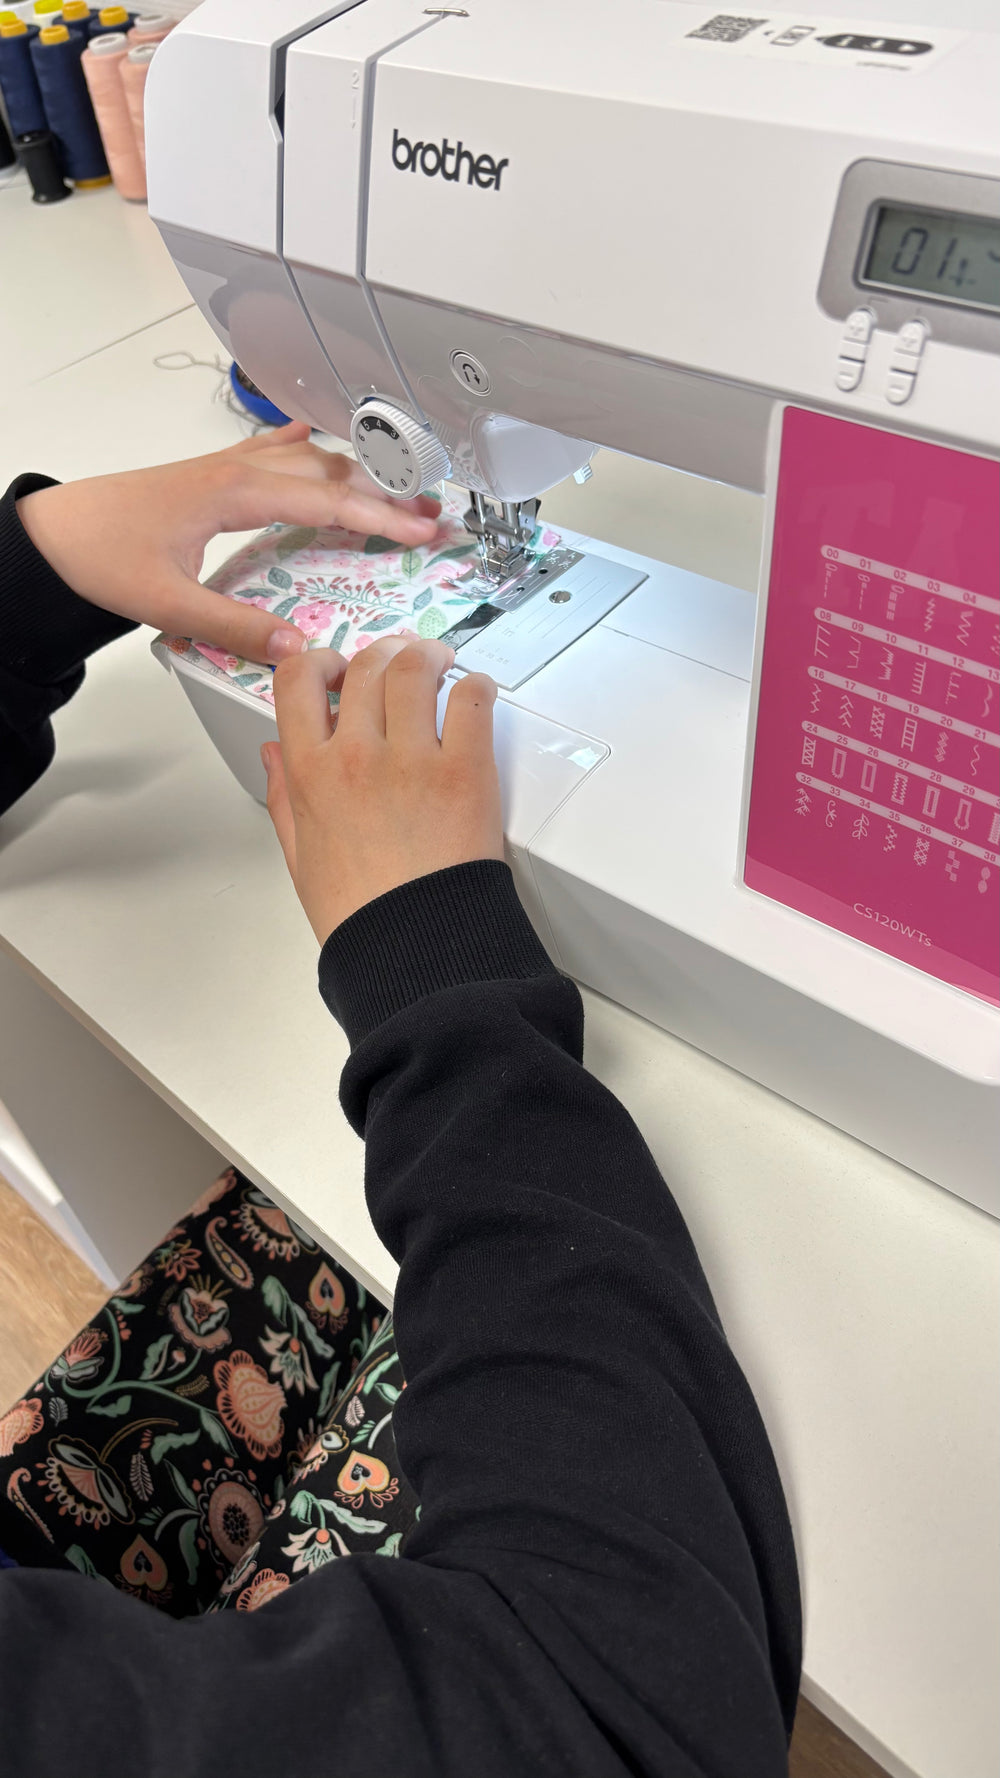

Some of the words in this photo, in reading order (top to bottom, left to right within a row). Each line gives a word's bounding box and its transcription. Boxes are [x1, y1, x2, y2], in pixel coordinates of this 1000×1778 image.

[392, 128, 509, 191] brother
[891, 227, 958, 279] 01
[363, 421, 370, 430] 5
[376, 419, 382, 428] 4
[390, 430, 397, 438] 3
[389, 479, 395, 488] 9
[400, 478, 407, 487] 0
[826, 549, 839, 559] 00
[860, 559, 872, 570] 01
[893, 569, 907, 581] 02
[927, 581, 940, 592] 03
[963, 592, 976, 604] 04
[820, 611, 831, 621] 08
[852, 621, 864, 633] 09
[886, 634, 897, 644] 10
[918, 645, 929, 655] 11
[952, 657, 964, 668] 12
[988, 669, 1000, 681] 13
[814, 669, 824, 679] 16
[845, 680, 856, 690] 17
[877, 692, 888, 702] 18
[908, 704, 919, 714] 19
[940, 716, 953, 727] 20
[975, 729, 986, 740] 21
[807, 723, 818, 734] 24
[837, 735, 848, 745] 25
[868, 747, 879, 757] 26
[897, 759, 909, 769] 27
[930, 772, 942, 782] 28
[963, 785, 975, 796] 29
[801, 774, 812, 784] 32
[829, 786, 841, 796] 33
[859, 799, 871, 809] 34
[889, 810, 900, 820] 35
[920, 824, 932, 834] 36
[952, 837, 964, 848] 37
[984, 852, 996, 862] 38
[853, 902, 932, 947] CS120WTs
